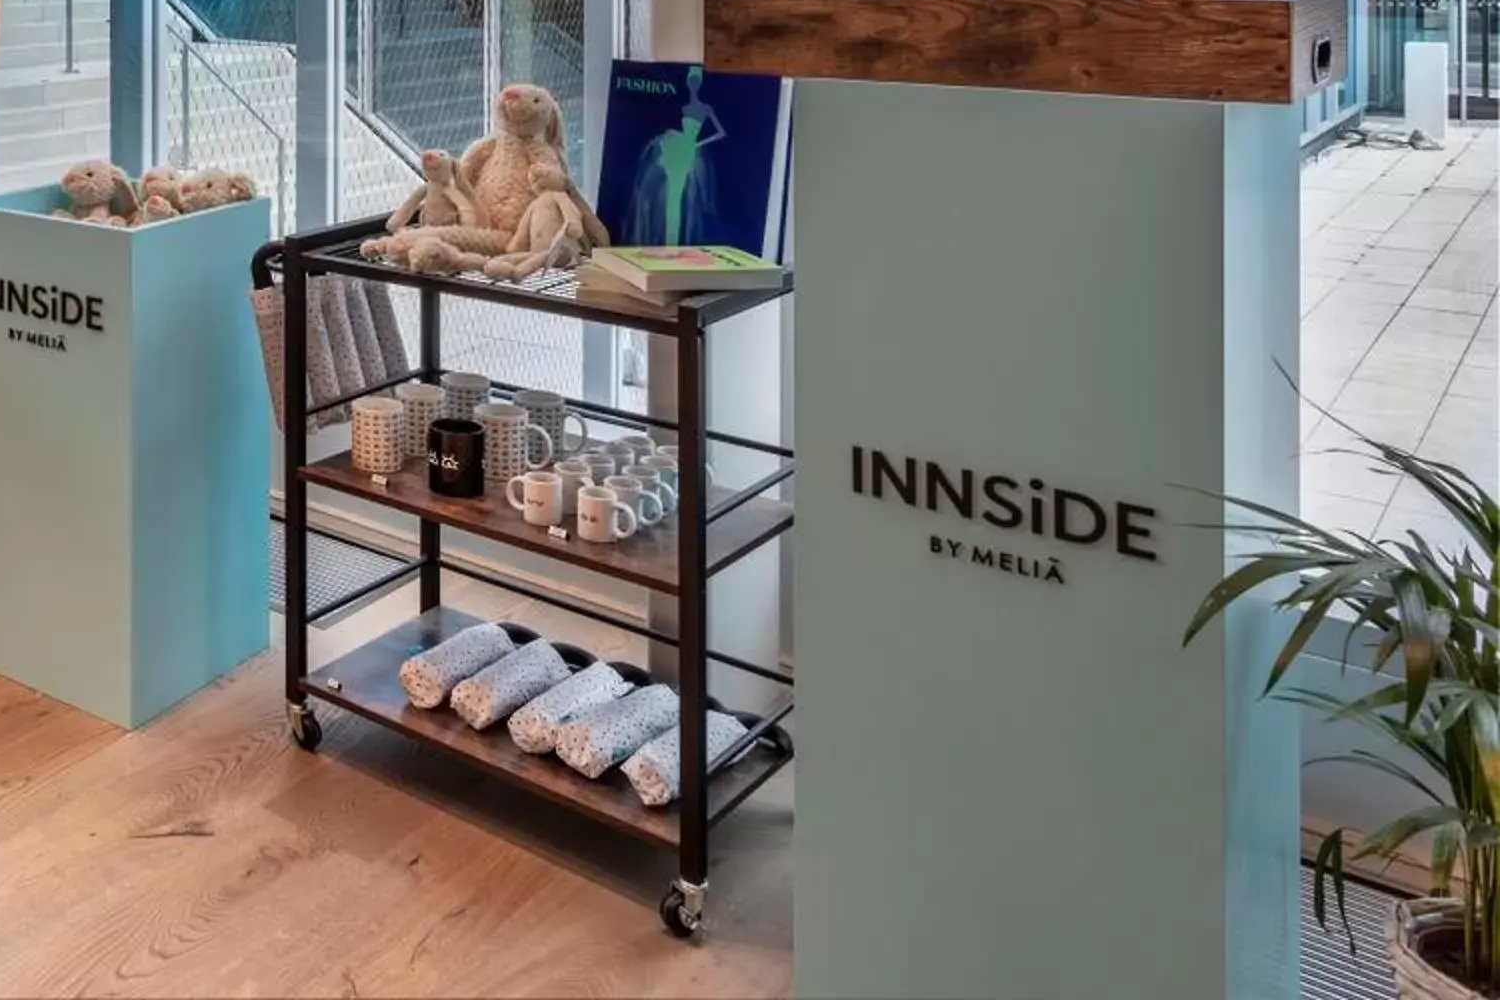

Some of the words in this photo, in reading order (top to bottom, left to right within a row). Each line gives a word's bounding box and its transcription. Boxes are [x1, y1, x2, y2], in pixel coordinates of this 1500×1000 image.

[616, 76, 677, 95] FASHION
[8, 327, 22, 341] BY
[852, 445, 1158, 561] INNSiDE
[930, 535, 962, 558] BY
